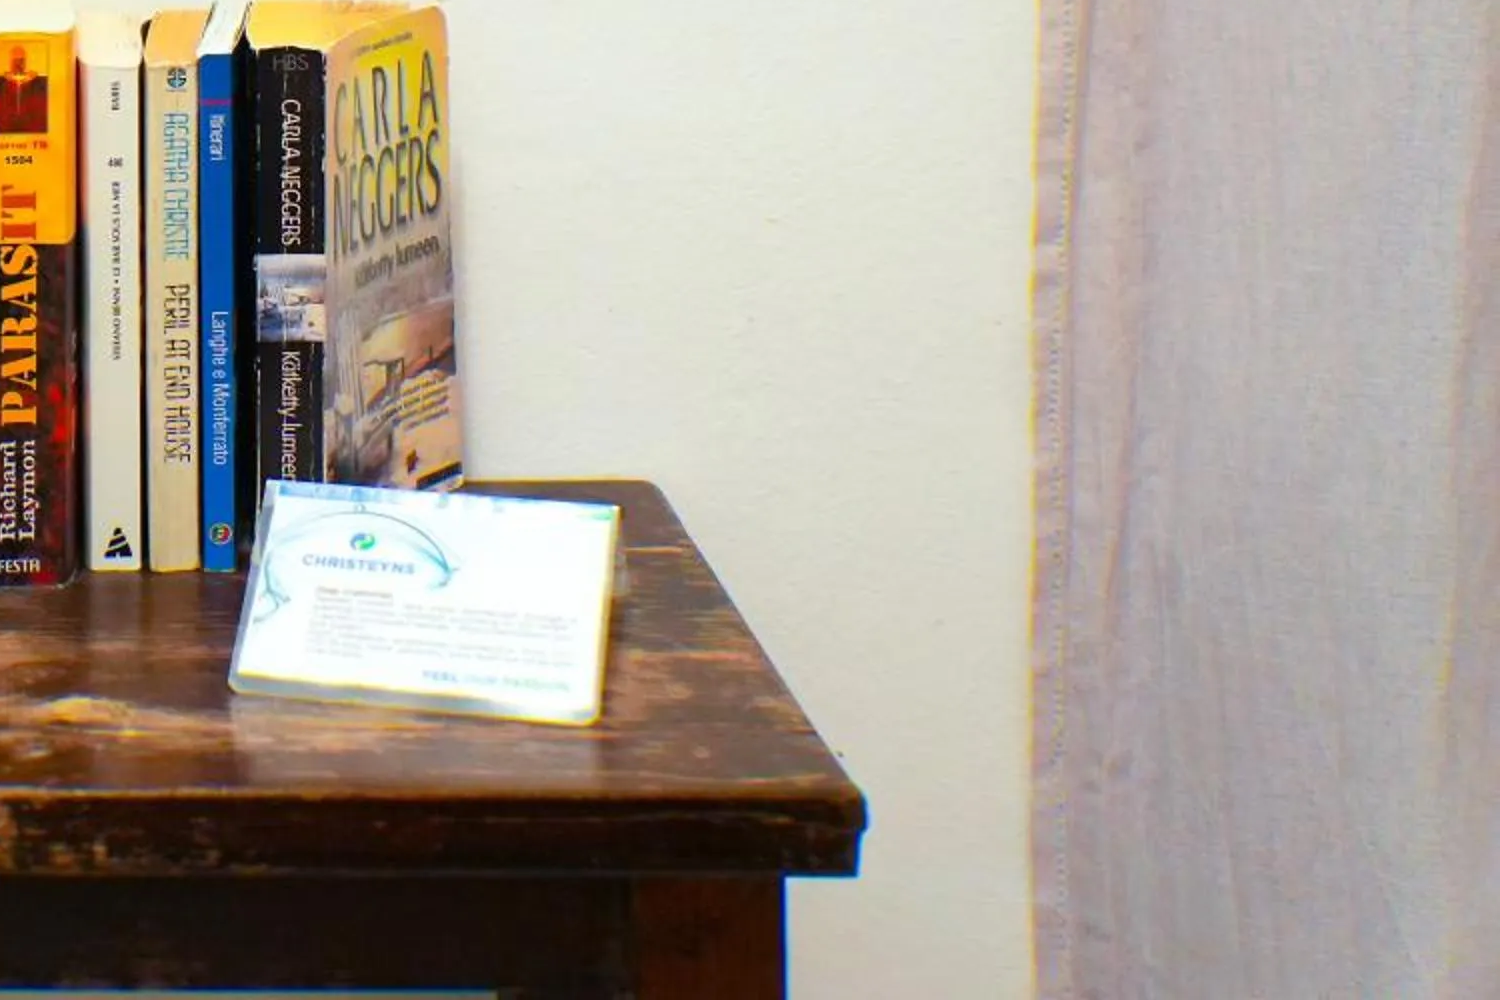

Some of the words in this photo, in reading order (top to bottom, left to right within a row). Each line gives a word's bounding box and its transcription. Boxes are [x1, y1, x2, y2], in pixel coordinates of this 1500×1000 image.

[272, 53, 309, 72] HBS
[280, 98, 301, 160] CARLA
[333, 50, 439, 167] CARLA
[4, 155, 34, 165] 1504
[163, 112, 190, 184] AGATHA
[163, 187, 190, 262] CHRISTIE
[280, 164, 301, 247] NEGGERS
[333, 129, 442, 258] NEGGERS
[0, 184, 40, 427] PARASIT
[164, 283, 191, 336] PERIL
[164, 338, 191, 361] AT
[207, 311, 229, 366] Langhe
[164, 365, 191, 400] END
[212, 369, 227, 380] e
[164, 406, 192, 464] HOUSE
[211, 382, 231, 465] Monferrato
[0, 440, 17, 544] Richard
[18, 440, 41, 541] Laymon
[301, 551, 417, 577] CHRISTEYNS
